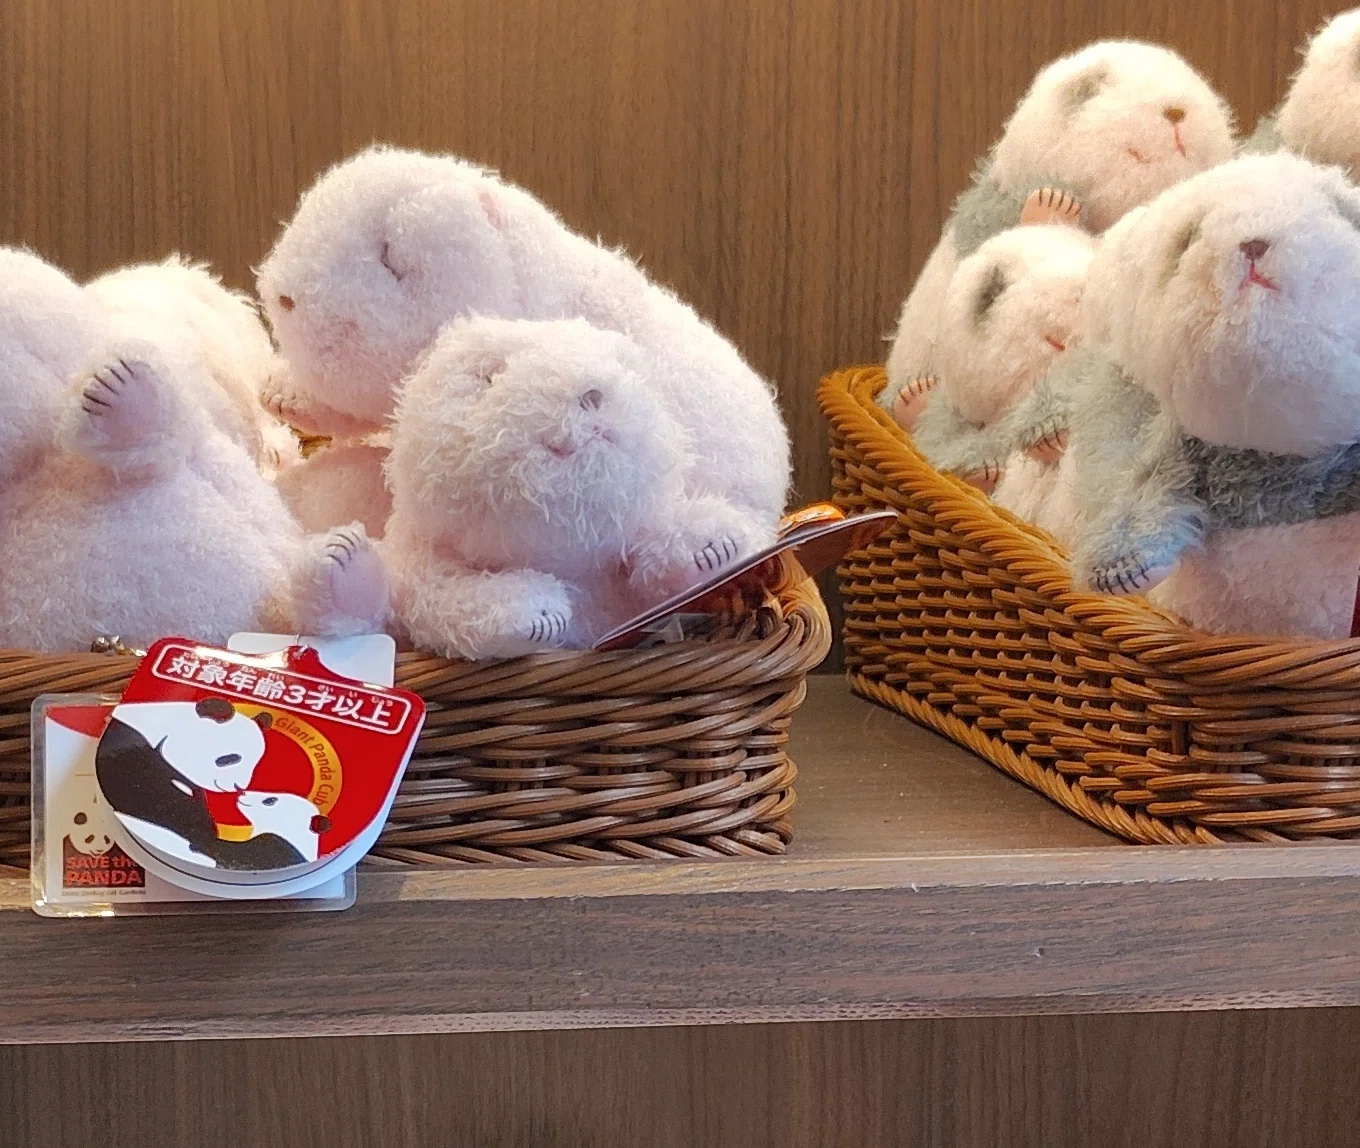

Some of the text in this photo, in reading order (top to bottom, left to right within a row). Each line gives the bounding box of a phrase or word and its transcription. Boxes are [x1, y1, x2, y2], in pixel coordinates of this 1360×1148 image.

[166, 656, 391, 727] 対象年齢3才以上
[275, 717, 315, 744] Giant
[308, 743, 336, 780] Panda
[65, 870, 143, 885] PANDA
[67, 856, 110, 869] SAVE
